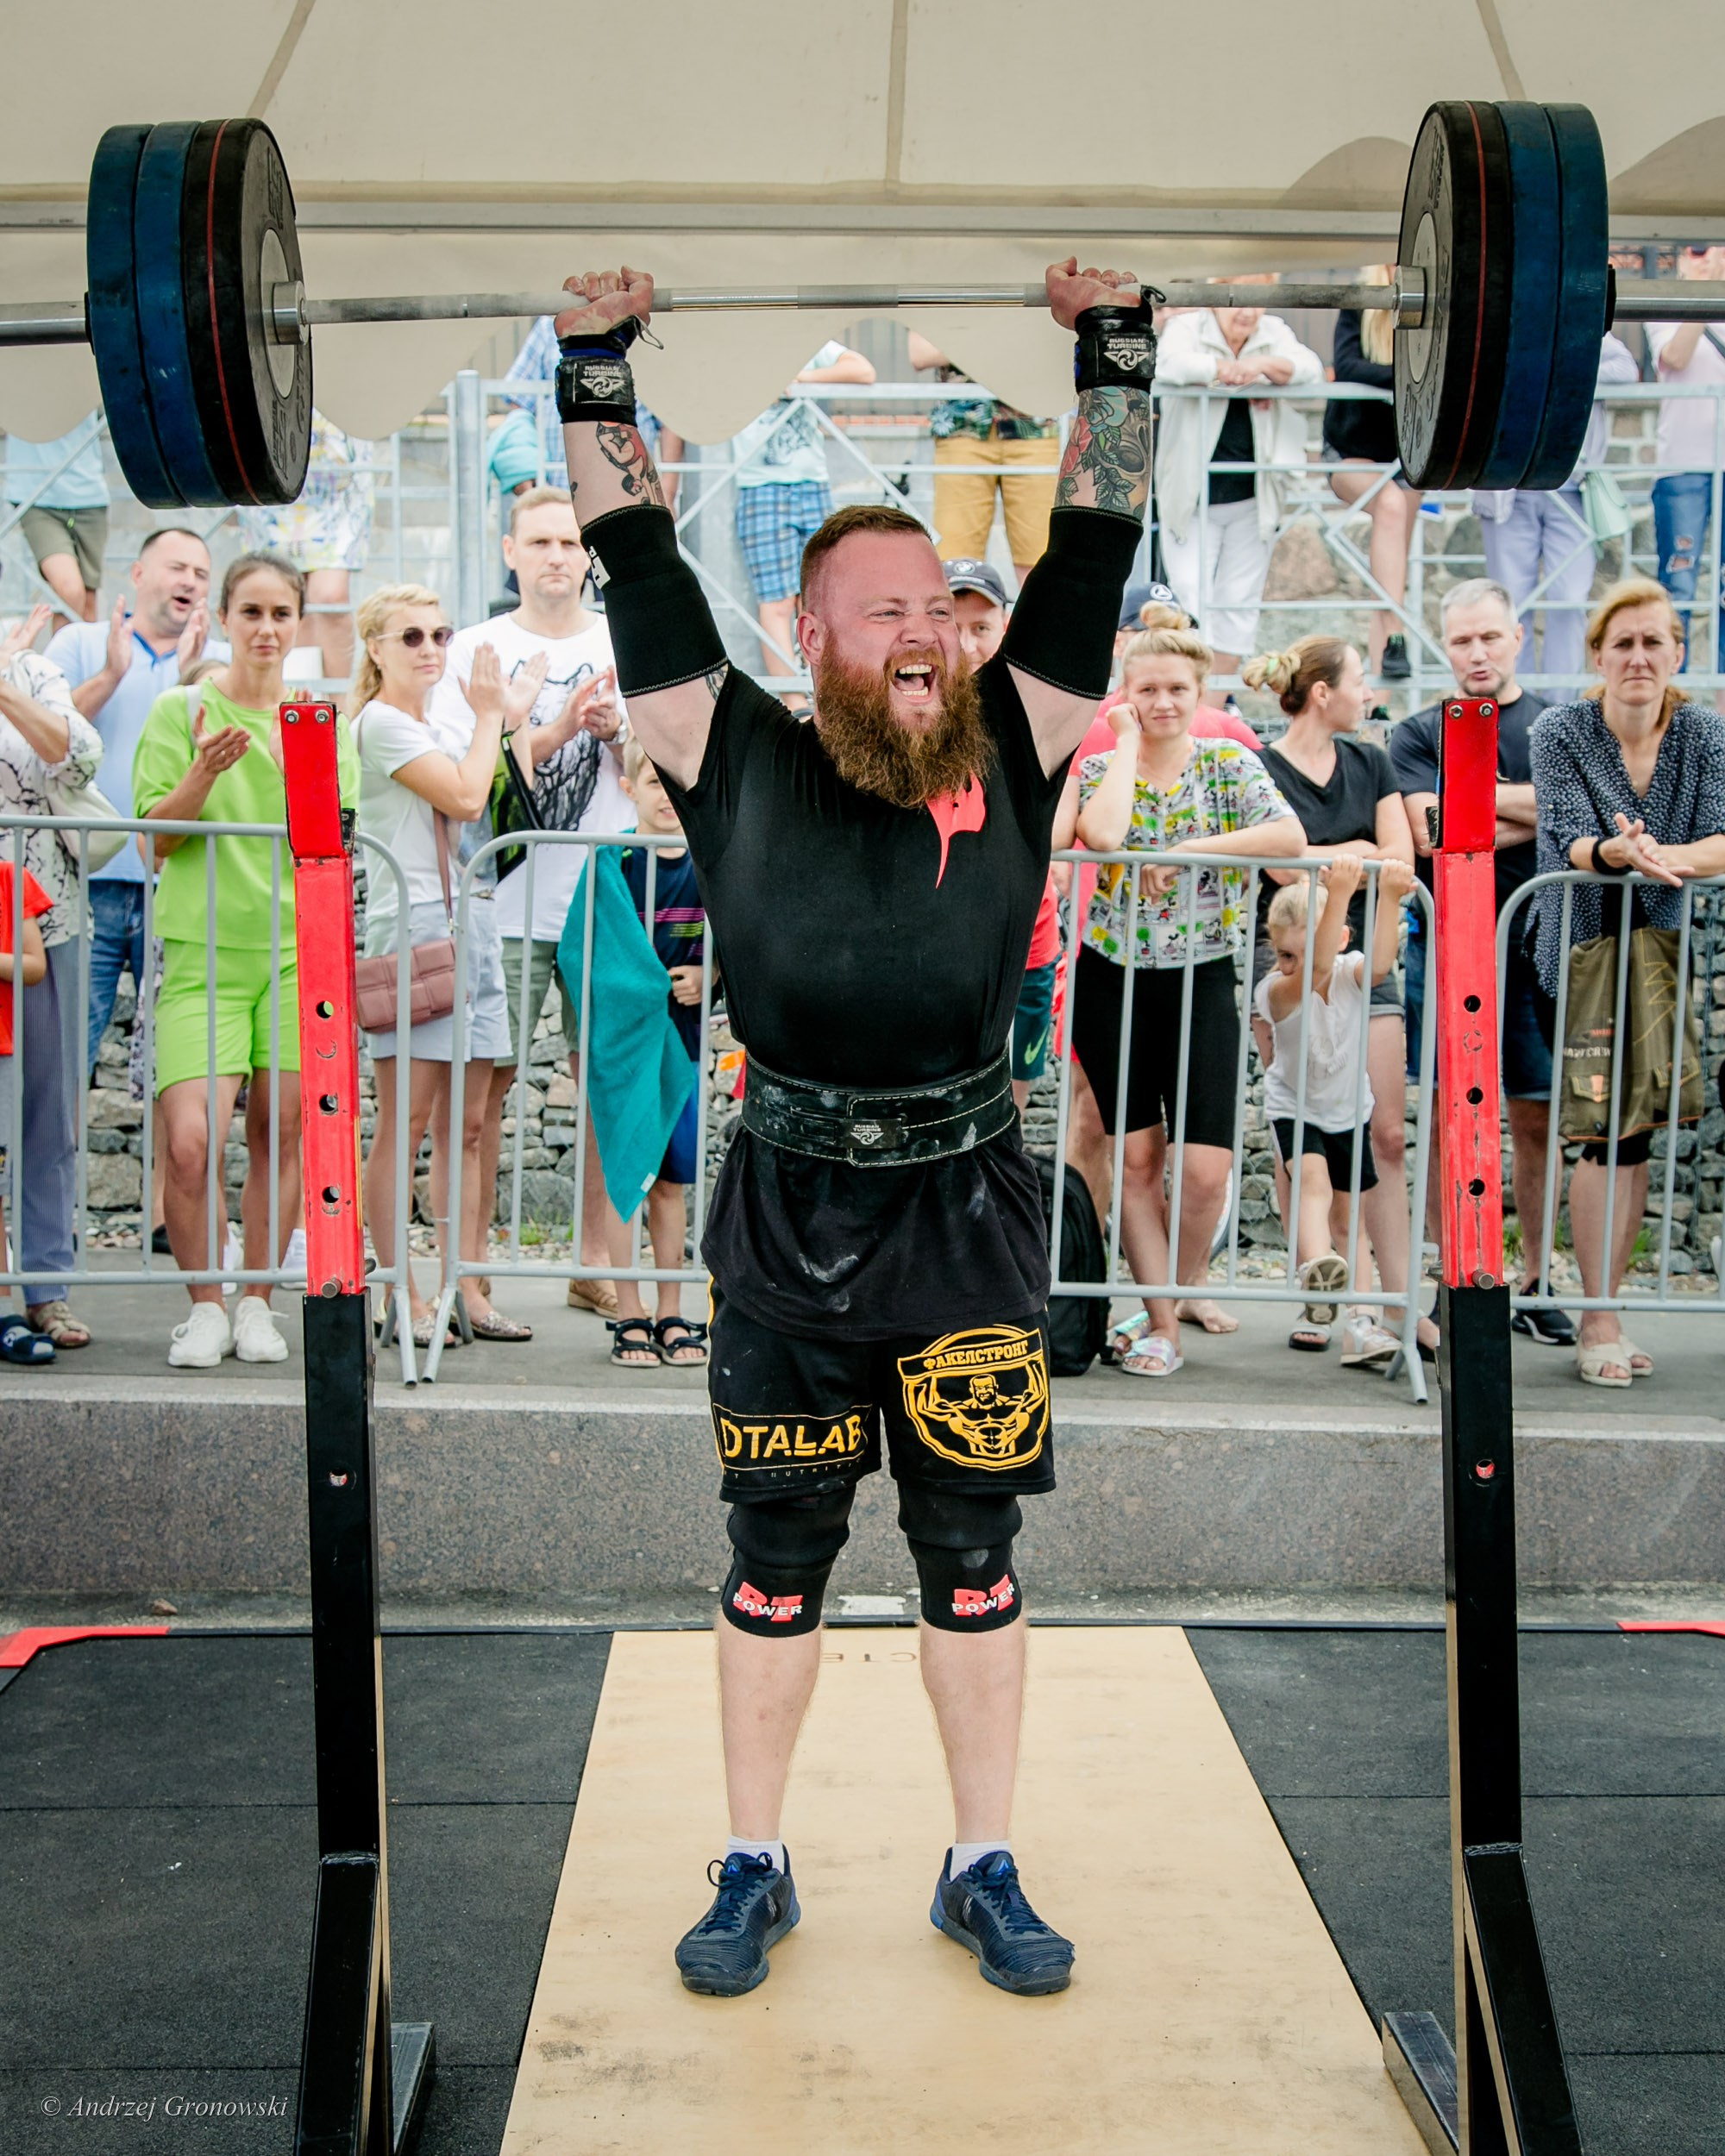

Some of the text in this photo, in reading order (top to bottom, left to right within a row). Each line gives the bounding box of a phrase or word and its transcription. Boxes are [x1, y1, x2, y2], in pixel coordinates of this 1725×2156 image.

[923, 1340, 1028, 1370] ФАКЕЛСТРОНГ
[733, 1592, 803, 1616] POWER
[951, 1583, 1015, 1613] POWER
